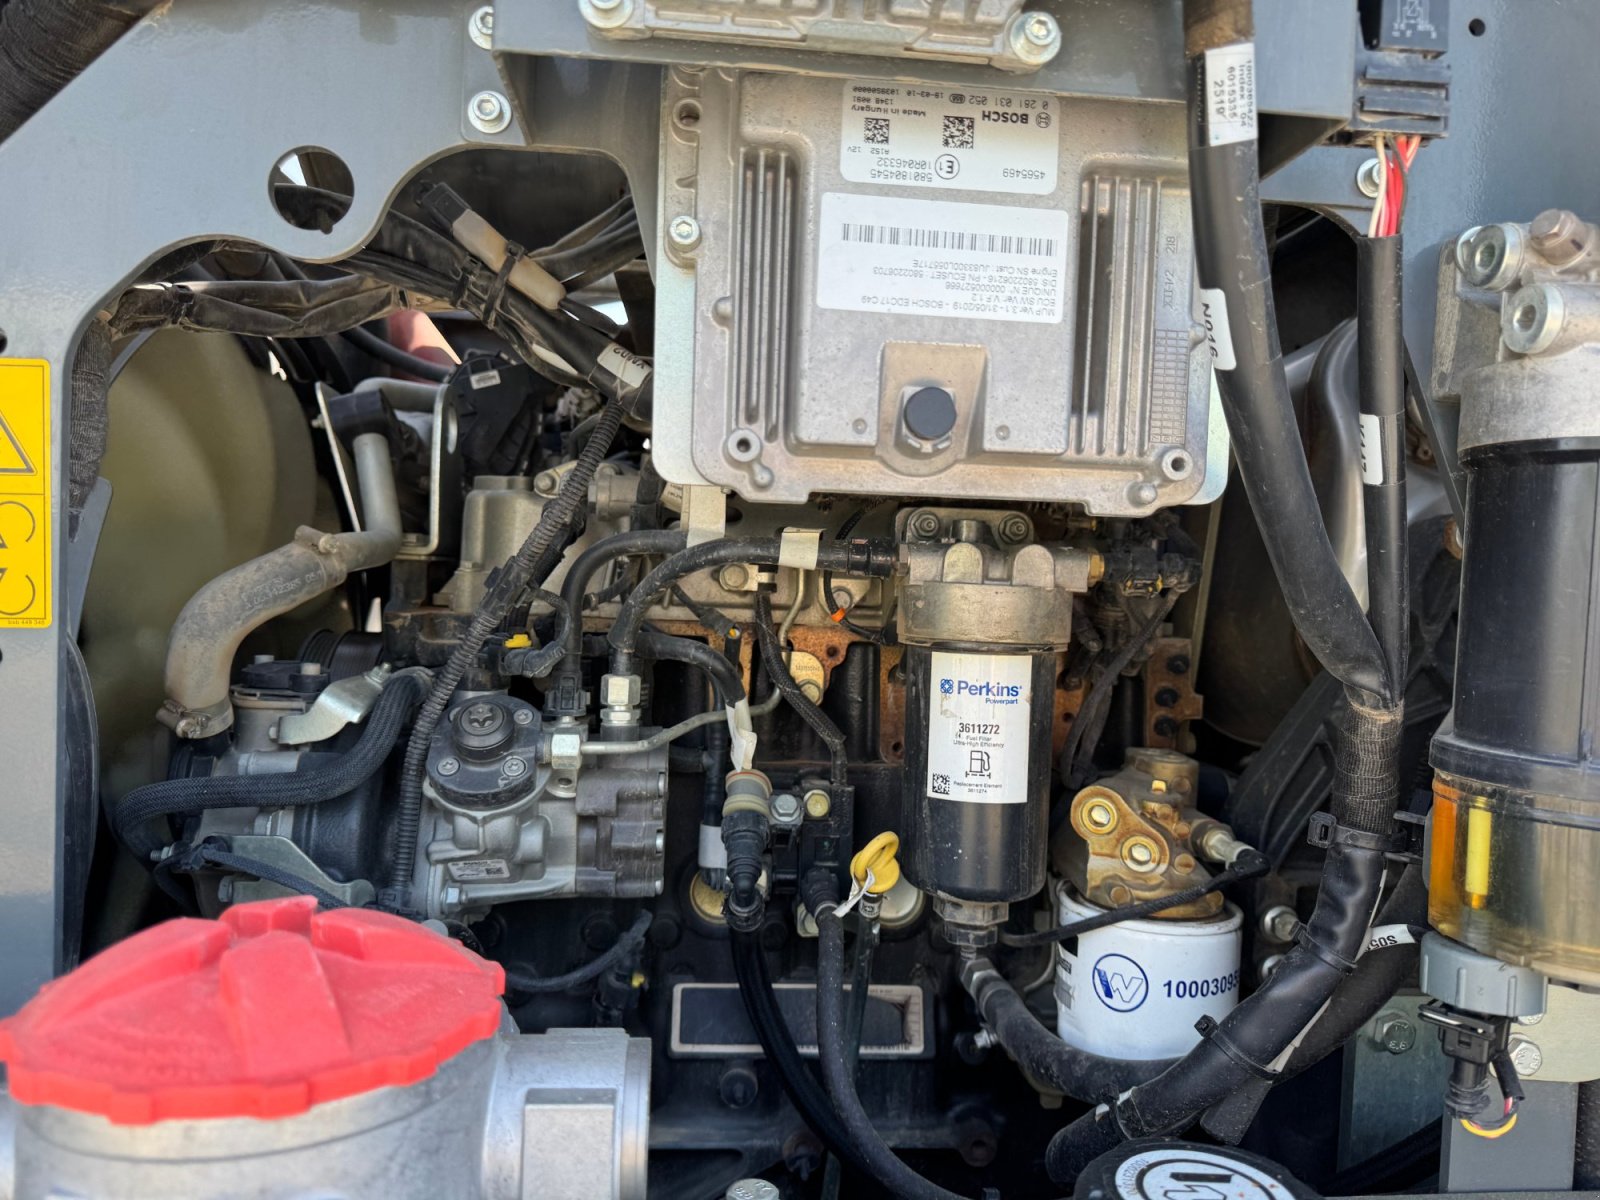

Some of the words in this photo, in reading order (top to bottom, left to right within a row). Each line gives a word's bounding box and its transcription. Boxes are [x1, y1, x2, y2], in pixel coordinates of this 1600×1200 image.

[968, 95, 987, 105] 052
[995, 97, 1011, 107] 031
[1019, 99, 1036, 108] 281
[851, 104, 888, 115] Hungary
[1042, 101, 1048, 110] 0
[902, 109, 926, 117] Made
[982, 111, 1029, 124] BOSCH
[877, 158, 932, 169] 10R046332
[870, 169, 932, 182] 5801804545
[1003, 169, 1045, 179] 4565469
[929, 271, 966, 281] ECUSET
[1017, 267, 1029, 276] SN
[1031, 266, 1057, 278] Engine
[968, 274, 980, 282] PN
[1023, 286, 1056, 297] UNIQUE
[861, 296, 879, 304] C49
[881, 297, 910, 305] EDC17
[912, 298, 944, 308] BOSCH
[1020, 296, 1035, 305] SW
[1037, 298, 1055, 306] ECU
[953, 302, 998, 312] 31/05/2019
[1202, 303, 1219, 358] N016
[958, 680, 1019, 696] Perkins
[959, 723, 1000, 735] 3611272
[953, 739, 979, 748] Ultra-High
